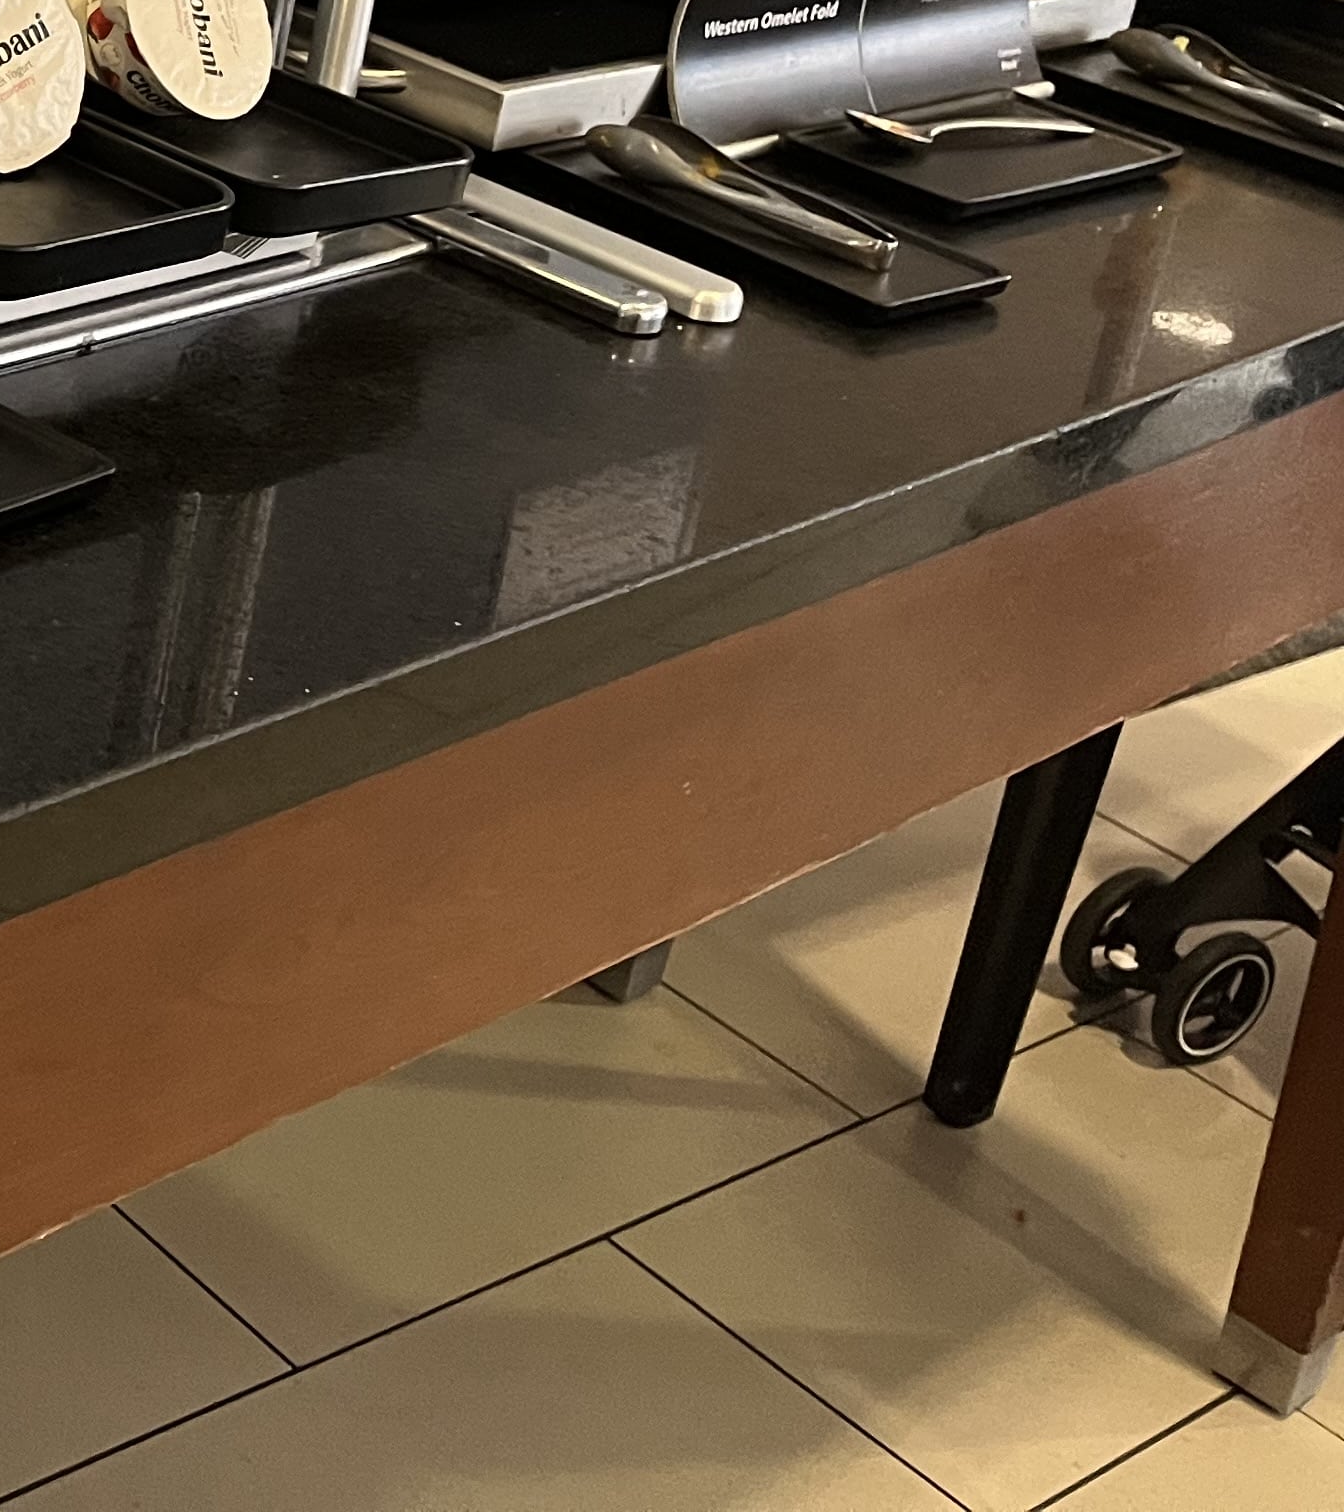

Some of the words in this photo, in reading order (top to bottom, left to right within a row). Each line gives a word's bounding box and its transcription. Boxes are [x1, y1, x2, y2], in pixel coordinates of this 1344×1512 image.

[704, 17, 758, 39] Western
[760, 8, 810, 30] Omelet
[810, 0, 840, 21] Fold
[5, 61, 34, 84] Yogurt
